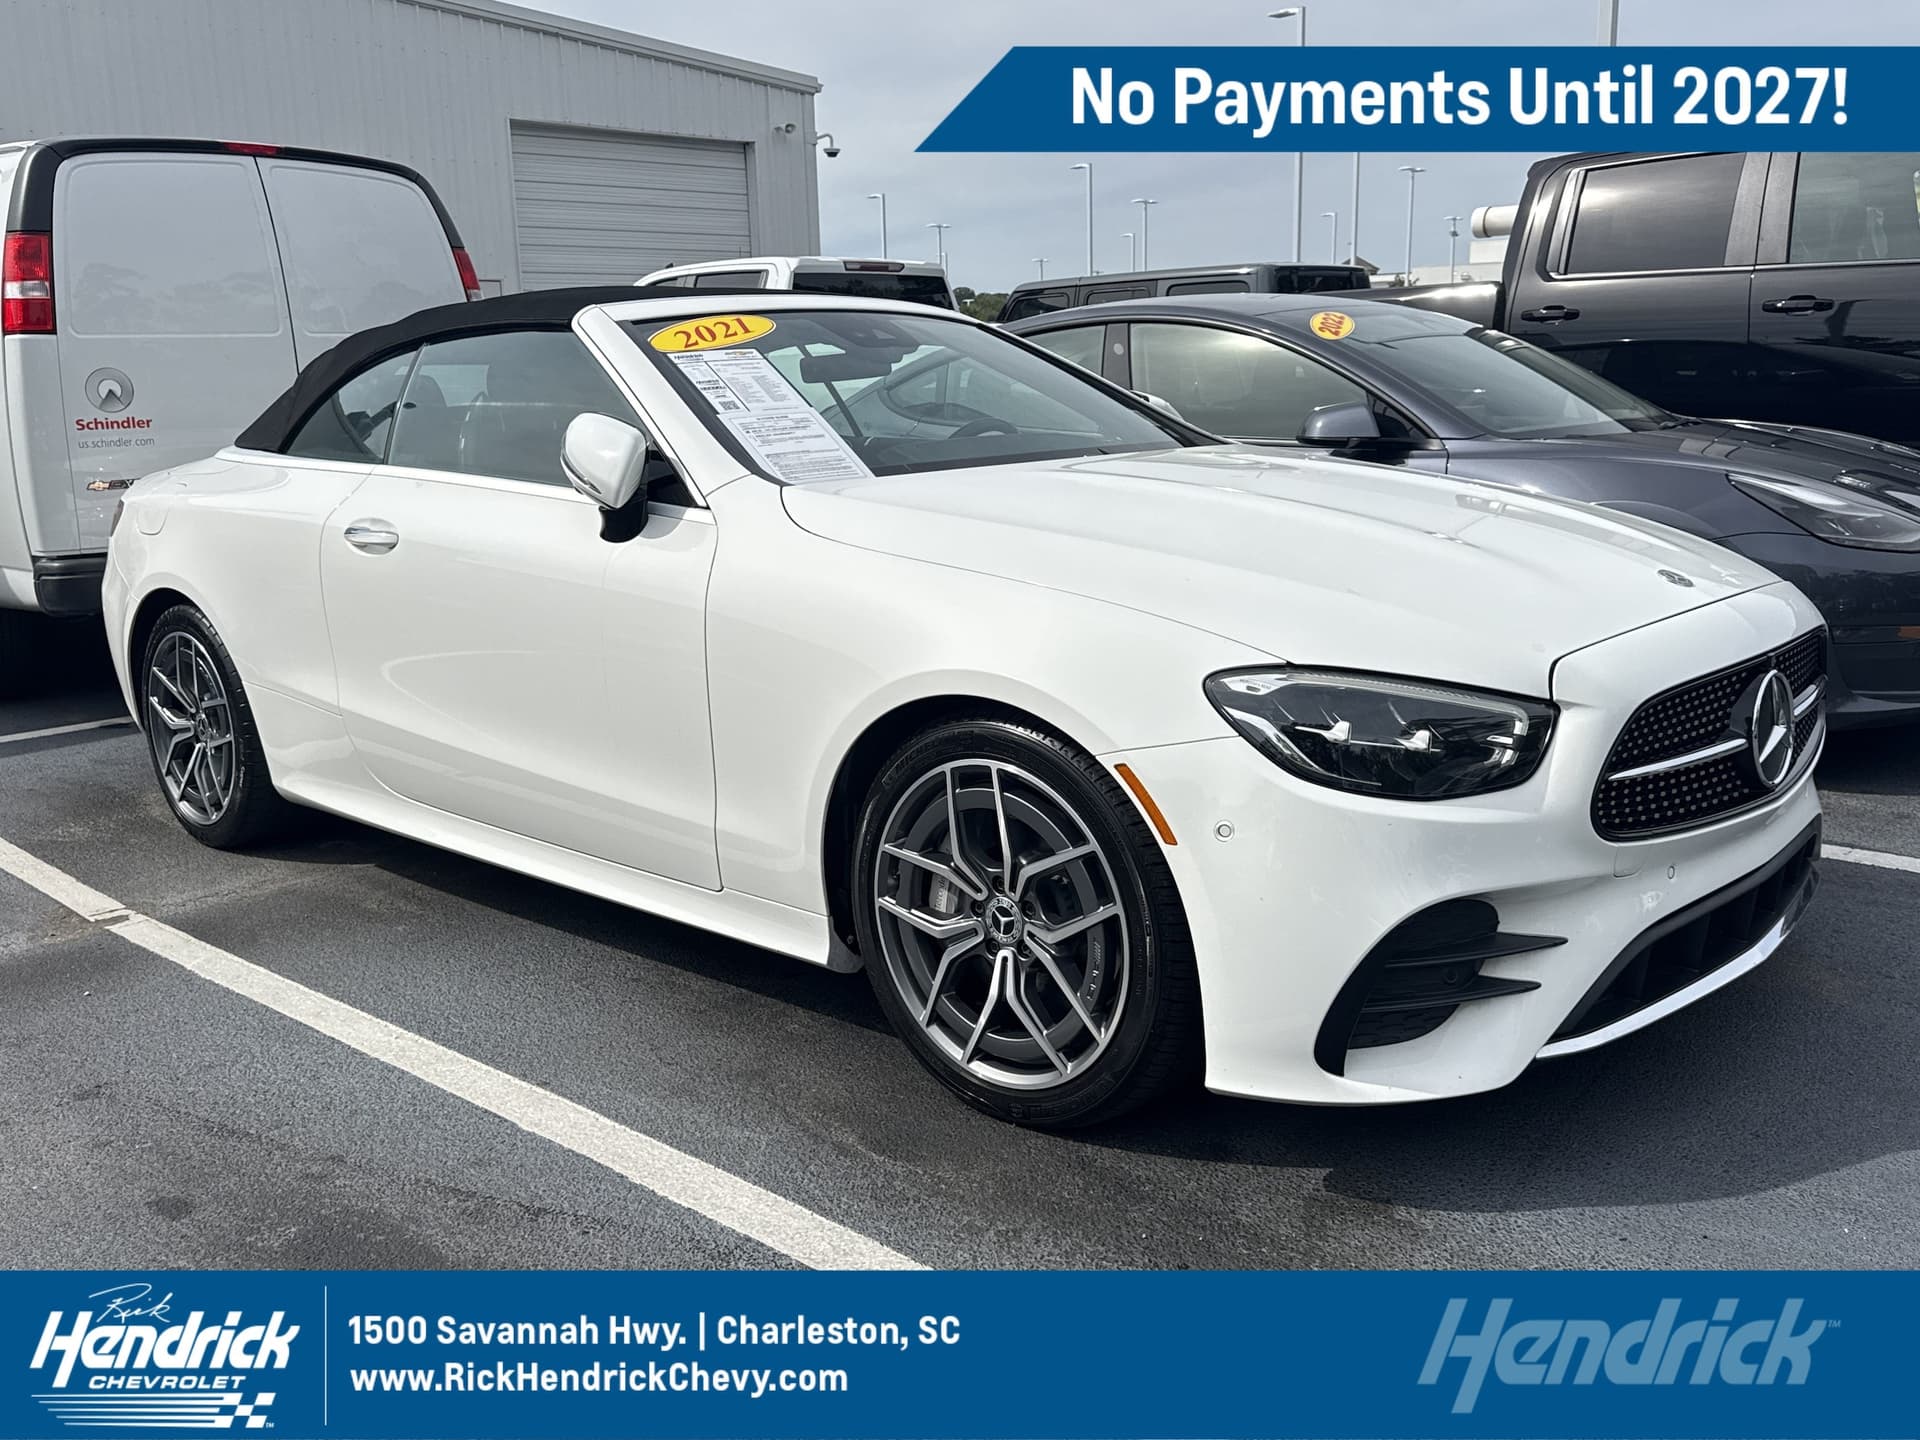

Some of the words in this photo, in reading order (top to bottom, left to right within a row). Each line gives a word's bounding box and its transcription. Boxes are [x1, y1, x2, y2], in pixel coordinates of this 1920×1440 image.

[674, 317, 753, 349] 2021
[75, 416, 152, 431] Schindler
[78, 436, 155, 449] us.schindler.com
